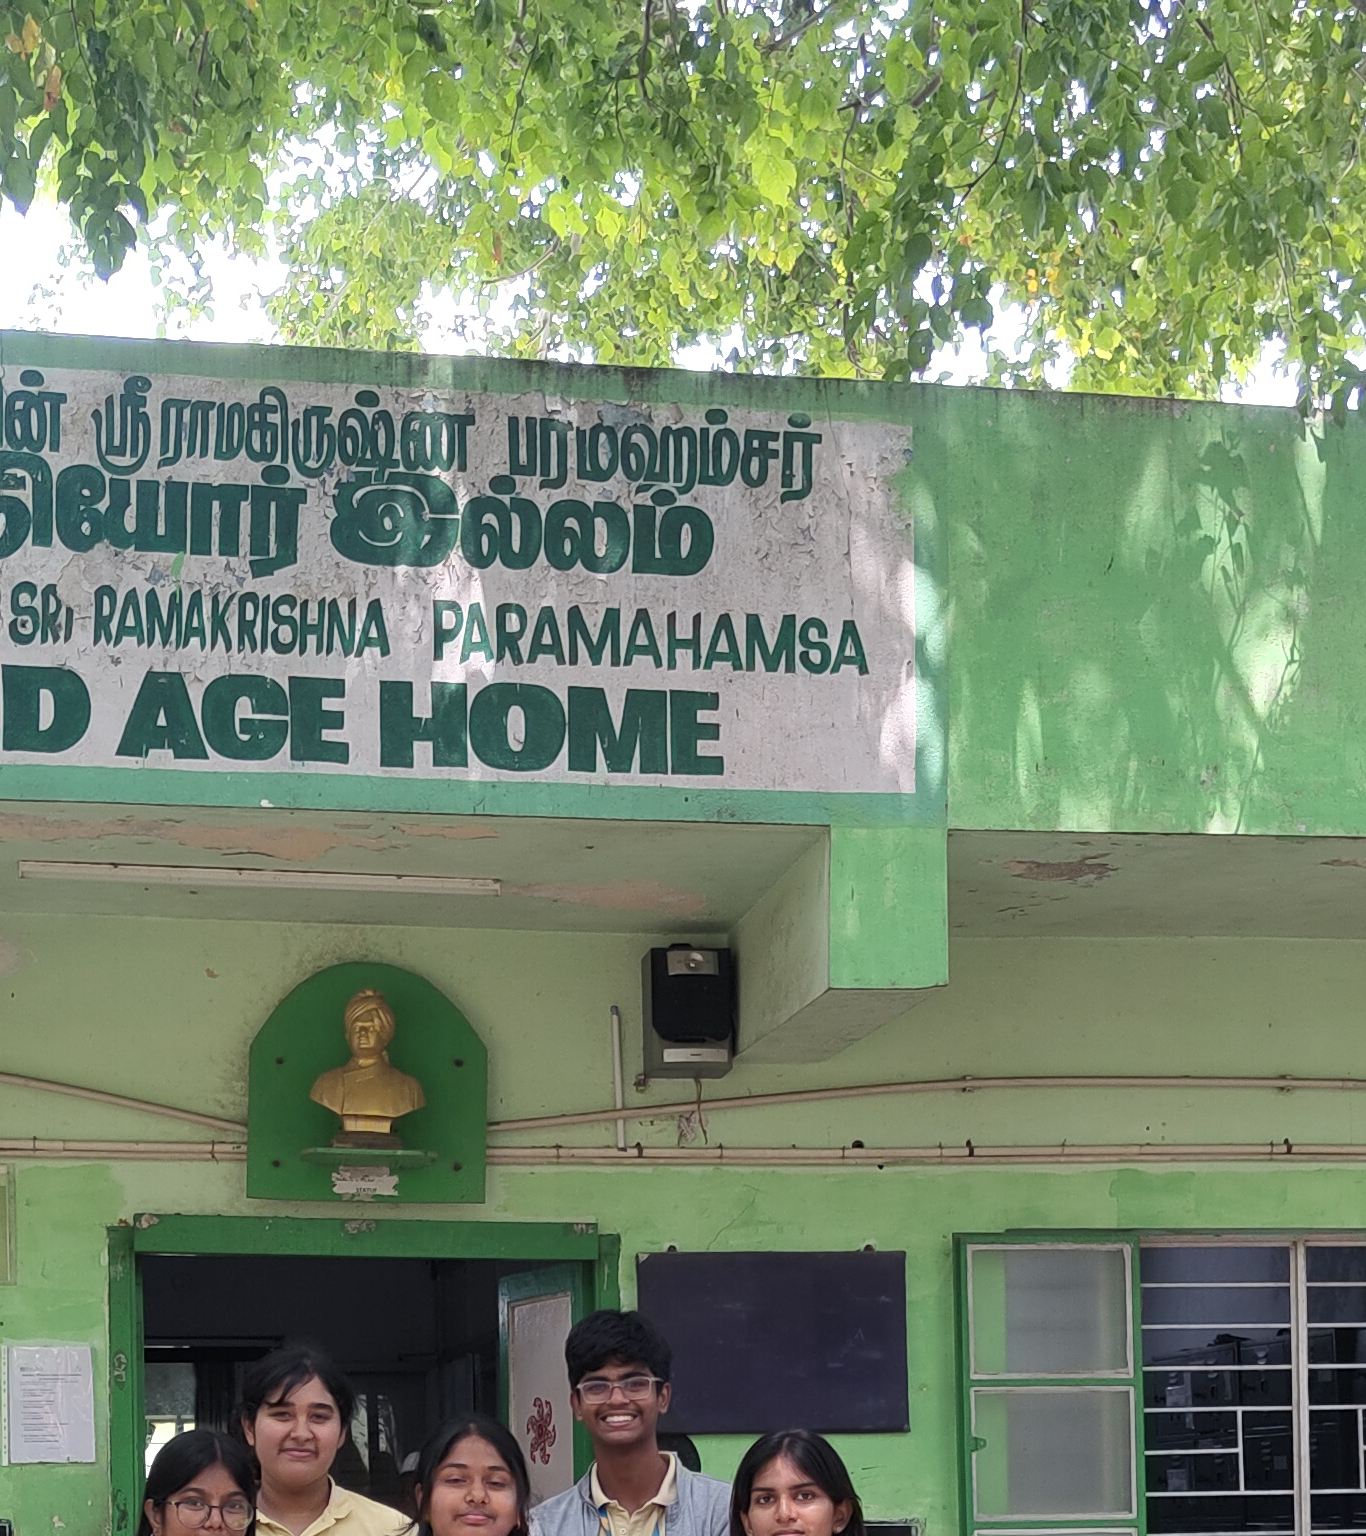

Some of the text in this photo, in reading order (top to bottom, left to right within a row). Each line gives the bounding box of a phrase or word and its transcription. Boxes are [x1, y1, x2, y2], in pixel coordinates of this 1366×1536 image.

[507, 408, 823, 504] பரமஹம்சர்
[330, 469, 715, 576] இல்லம்
[8, 580, 74, 646] SRI
[93, 583, 391, 660] RAMAKRISHNA
[432, 598, 870, 677] PARAMAHAMSA
[115, 669, 350, 766] AGE
[379, 679, 725, 778] HOME
